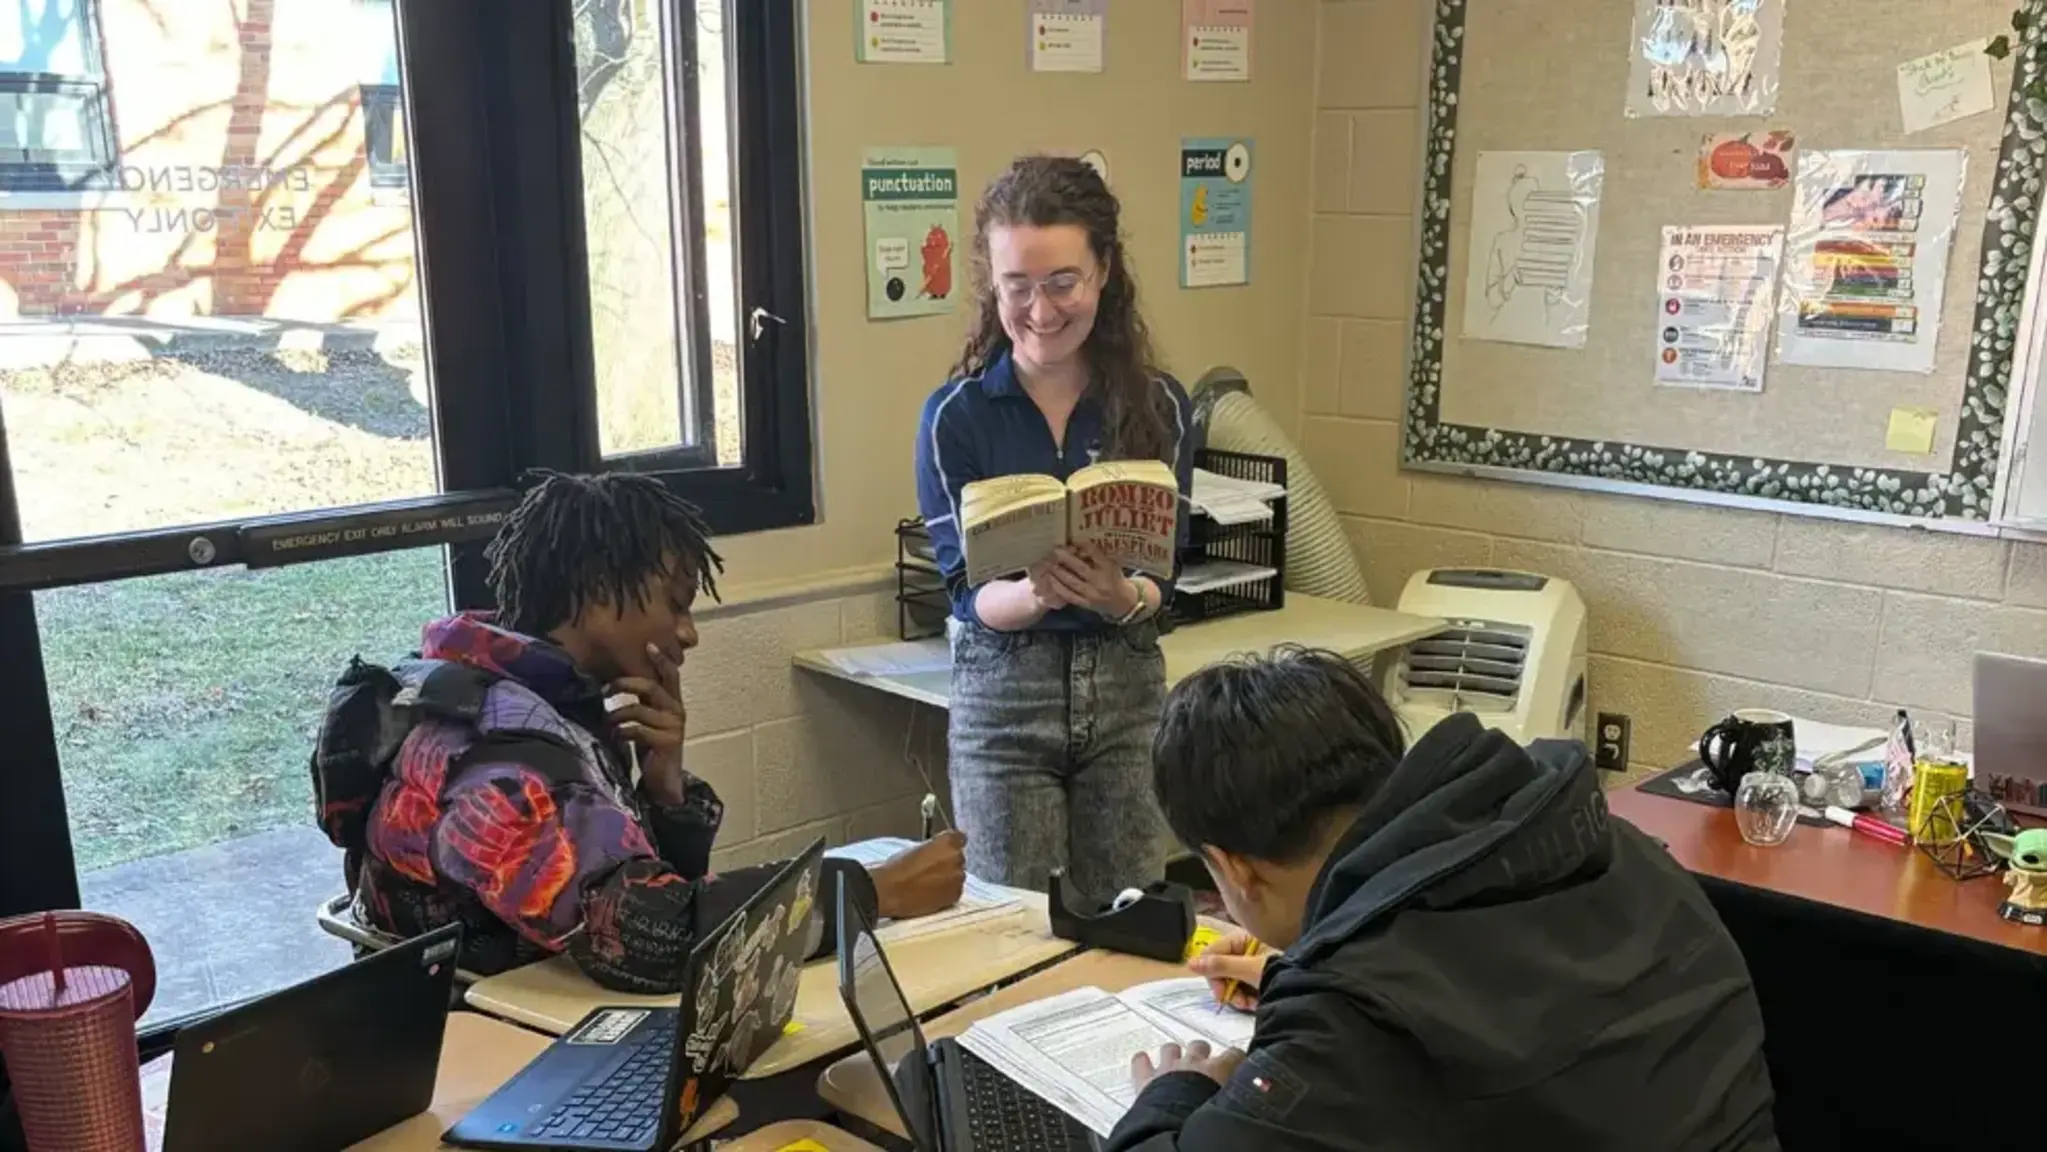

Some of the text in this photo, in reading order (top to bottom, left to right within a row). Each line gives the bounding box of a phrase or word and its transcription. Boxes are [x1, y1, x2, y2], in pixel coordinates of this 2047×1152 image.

[1186, 153, 1221, 175] period
[868, 171, 953, 198] punctuation
[1684, 233, 1701, 245] AN
[1704, 233, 1772, 246] EMERGENCY
[1080, 485, 1174, 509] ROMEO
[272, 511, 502, 551] EMERGENCY EXIT ONLY ALARM WILL SOUND
[1079, 508, 1174, 537] JULIET
